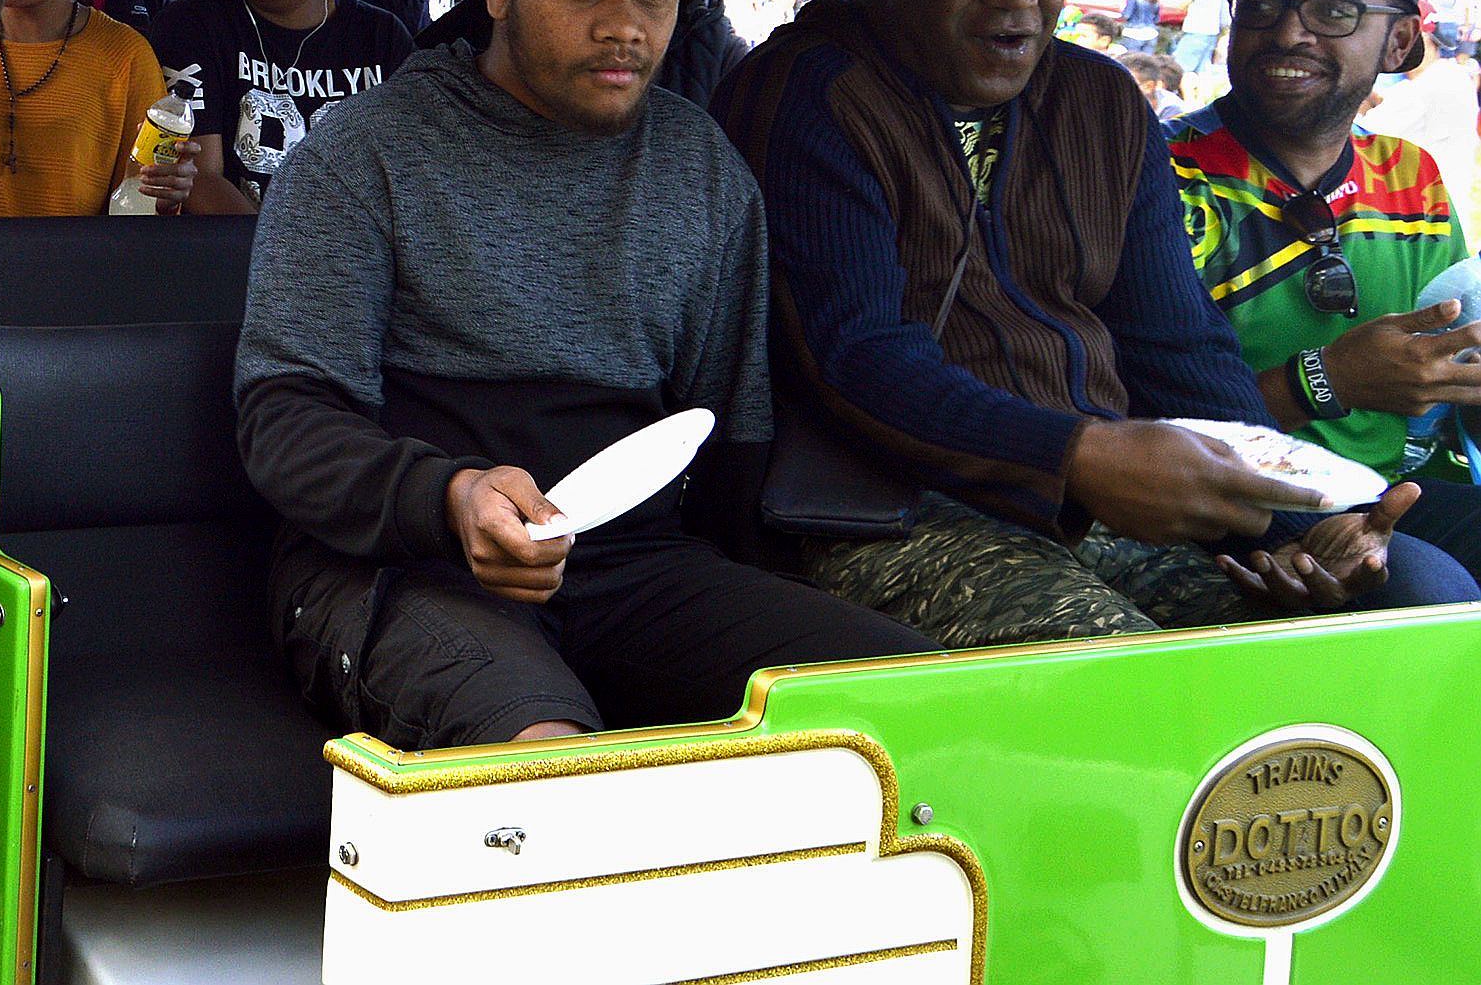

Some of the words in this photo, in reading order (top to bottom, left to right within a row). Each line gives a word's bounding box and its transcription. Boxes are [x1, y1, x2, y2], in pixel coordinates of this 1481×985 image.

[238, 51, 383, 98] BROOKLYN
[1307, 373, 1333, 403] DEAD
[1246, 754, 1344, 794] TRAINS
[1210, 803, 1369, 867] DOTTO
